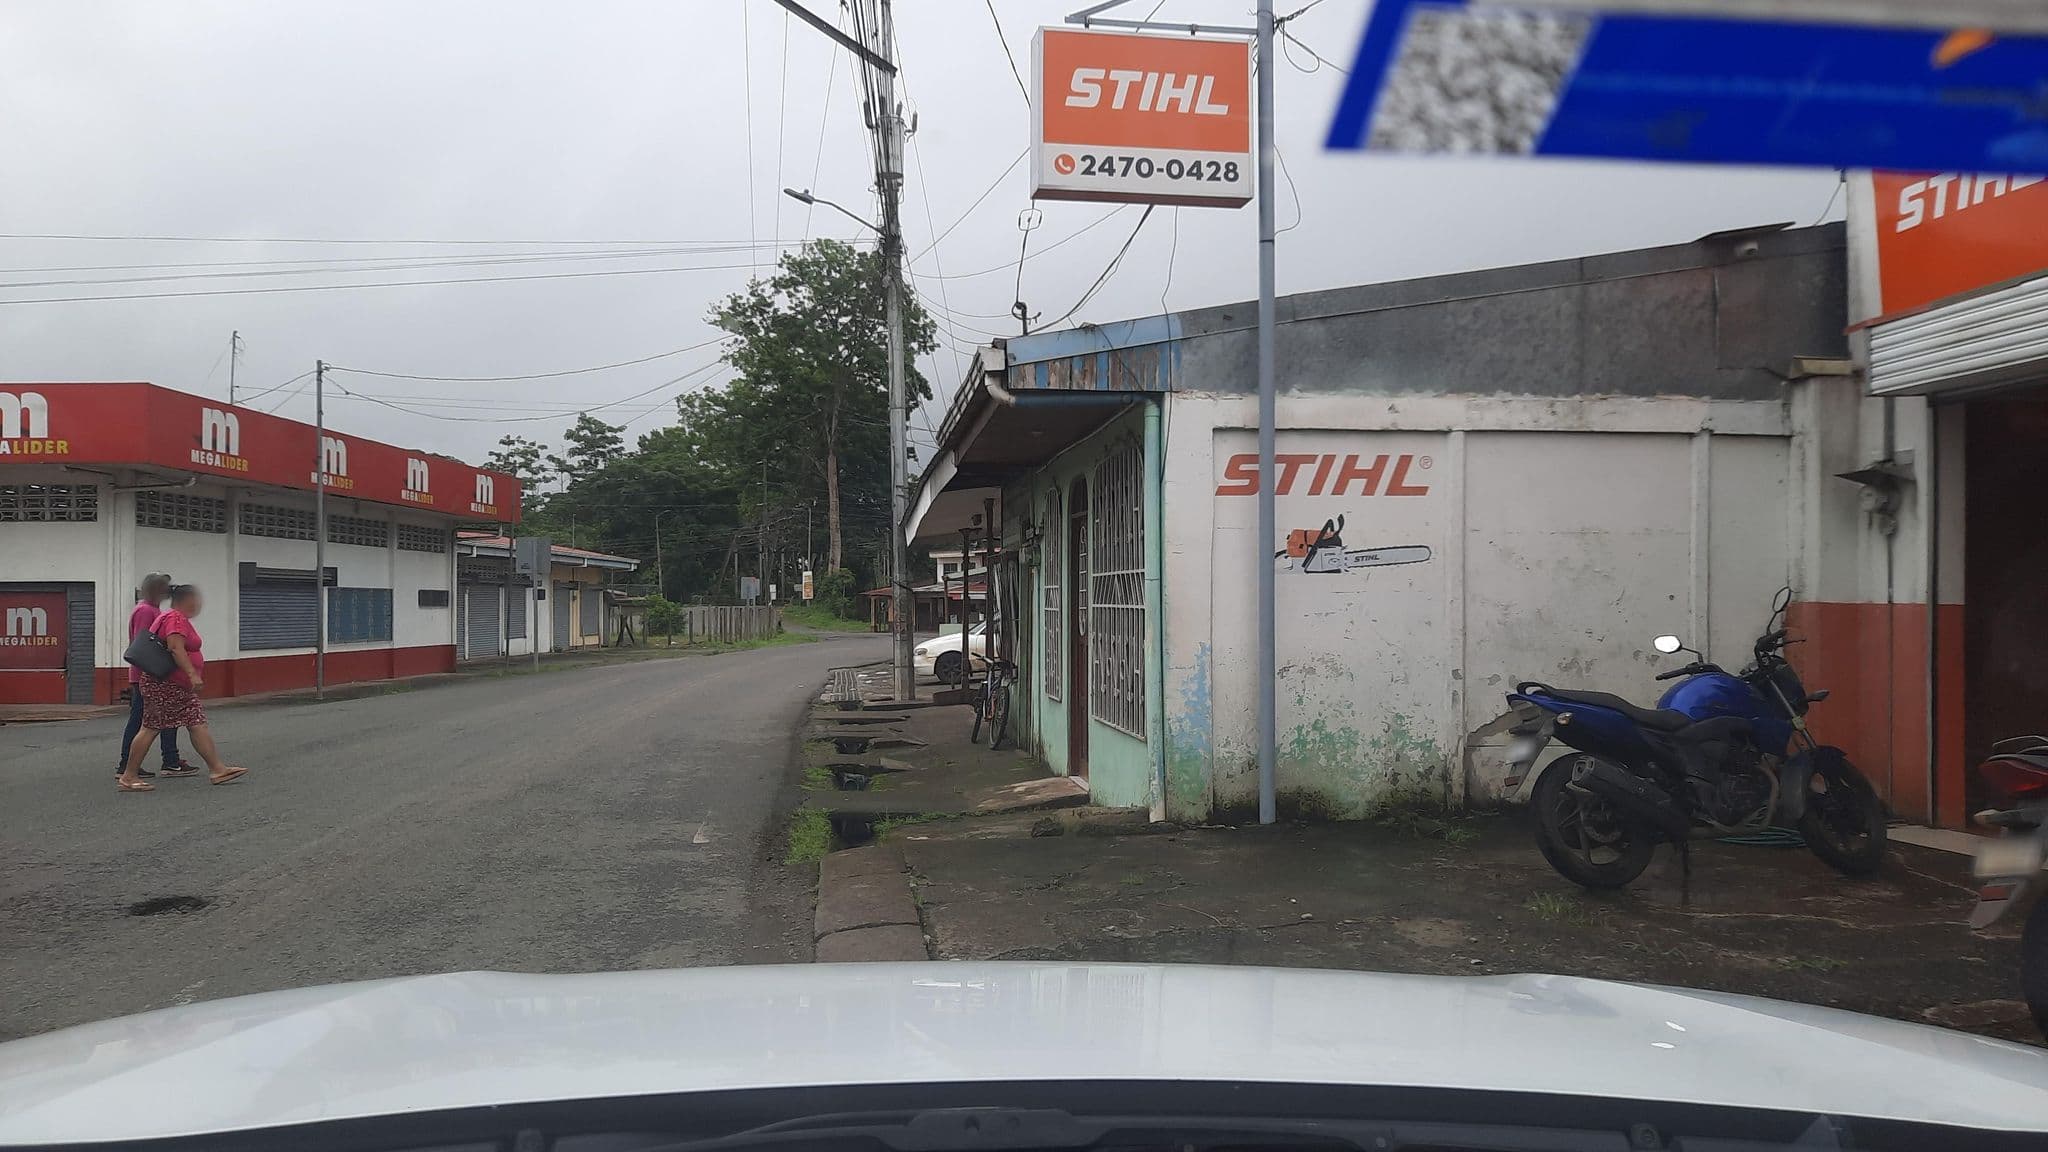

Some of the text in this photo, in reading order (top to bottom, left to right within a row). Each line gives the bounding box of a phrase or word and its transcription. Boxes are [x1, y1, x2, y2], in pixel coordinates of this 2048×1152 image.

[1064, 67, 1229, 115] STIHL
[1080, 154, 1240, 182] 2470-0428
[191, 449, 249, 472] MEGALIDER
[311, 471, 354, 490] MGALIDER
[1354, 554, 1381, 563] STIHL
